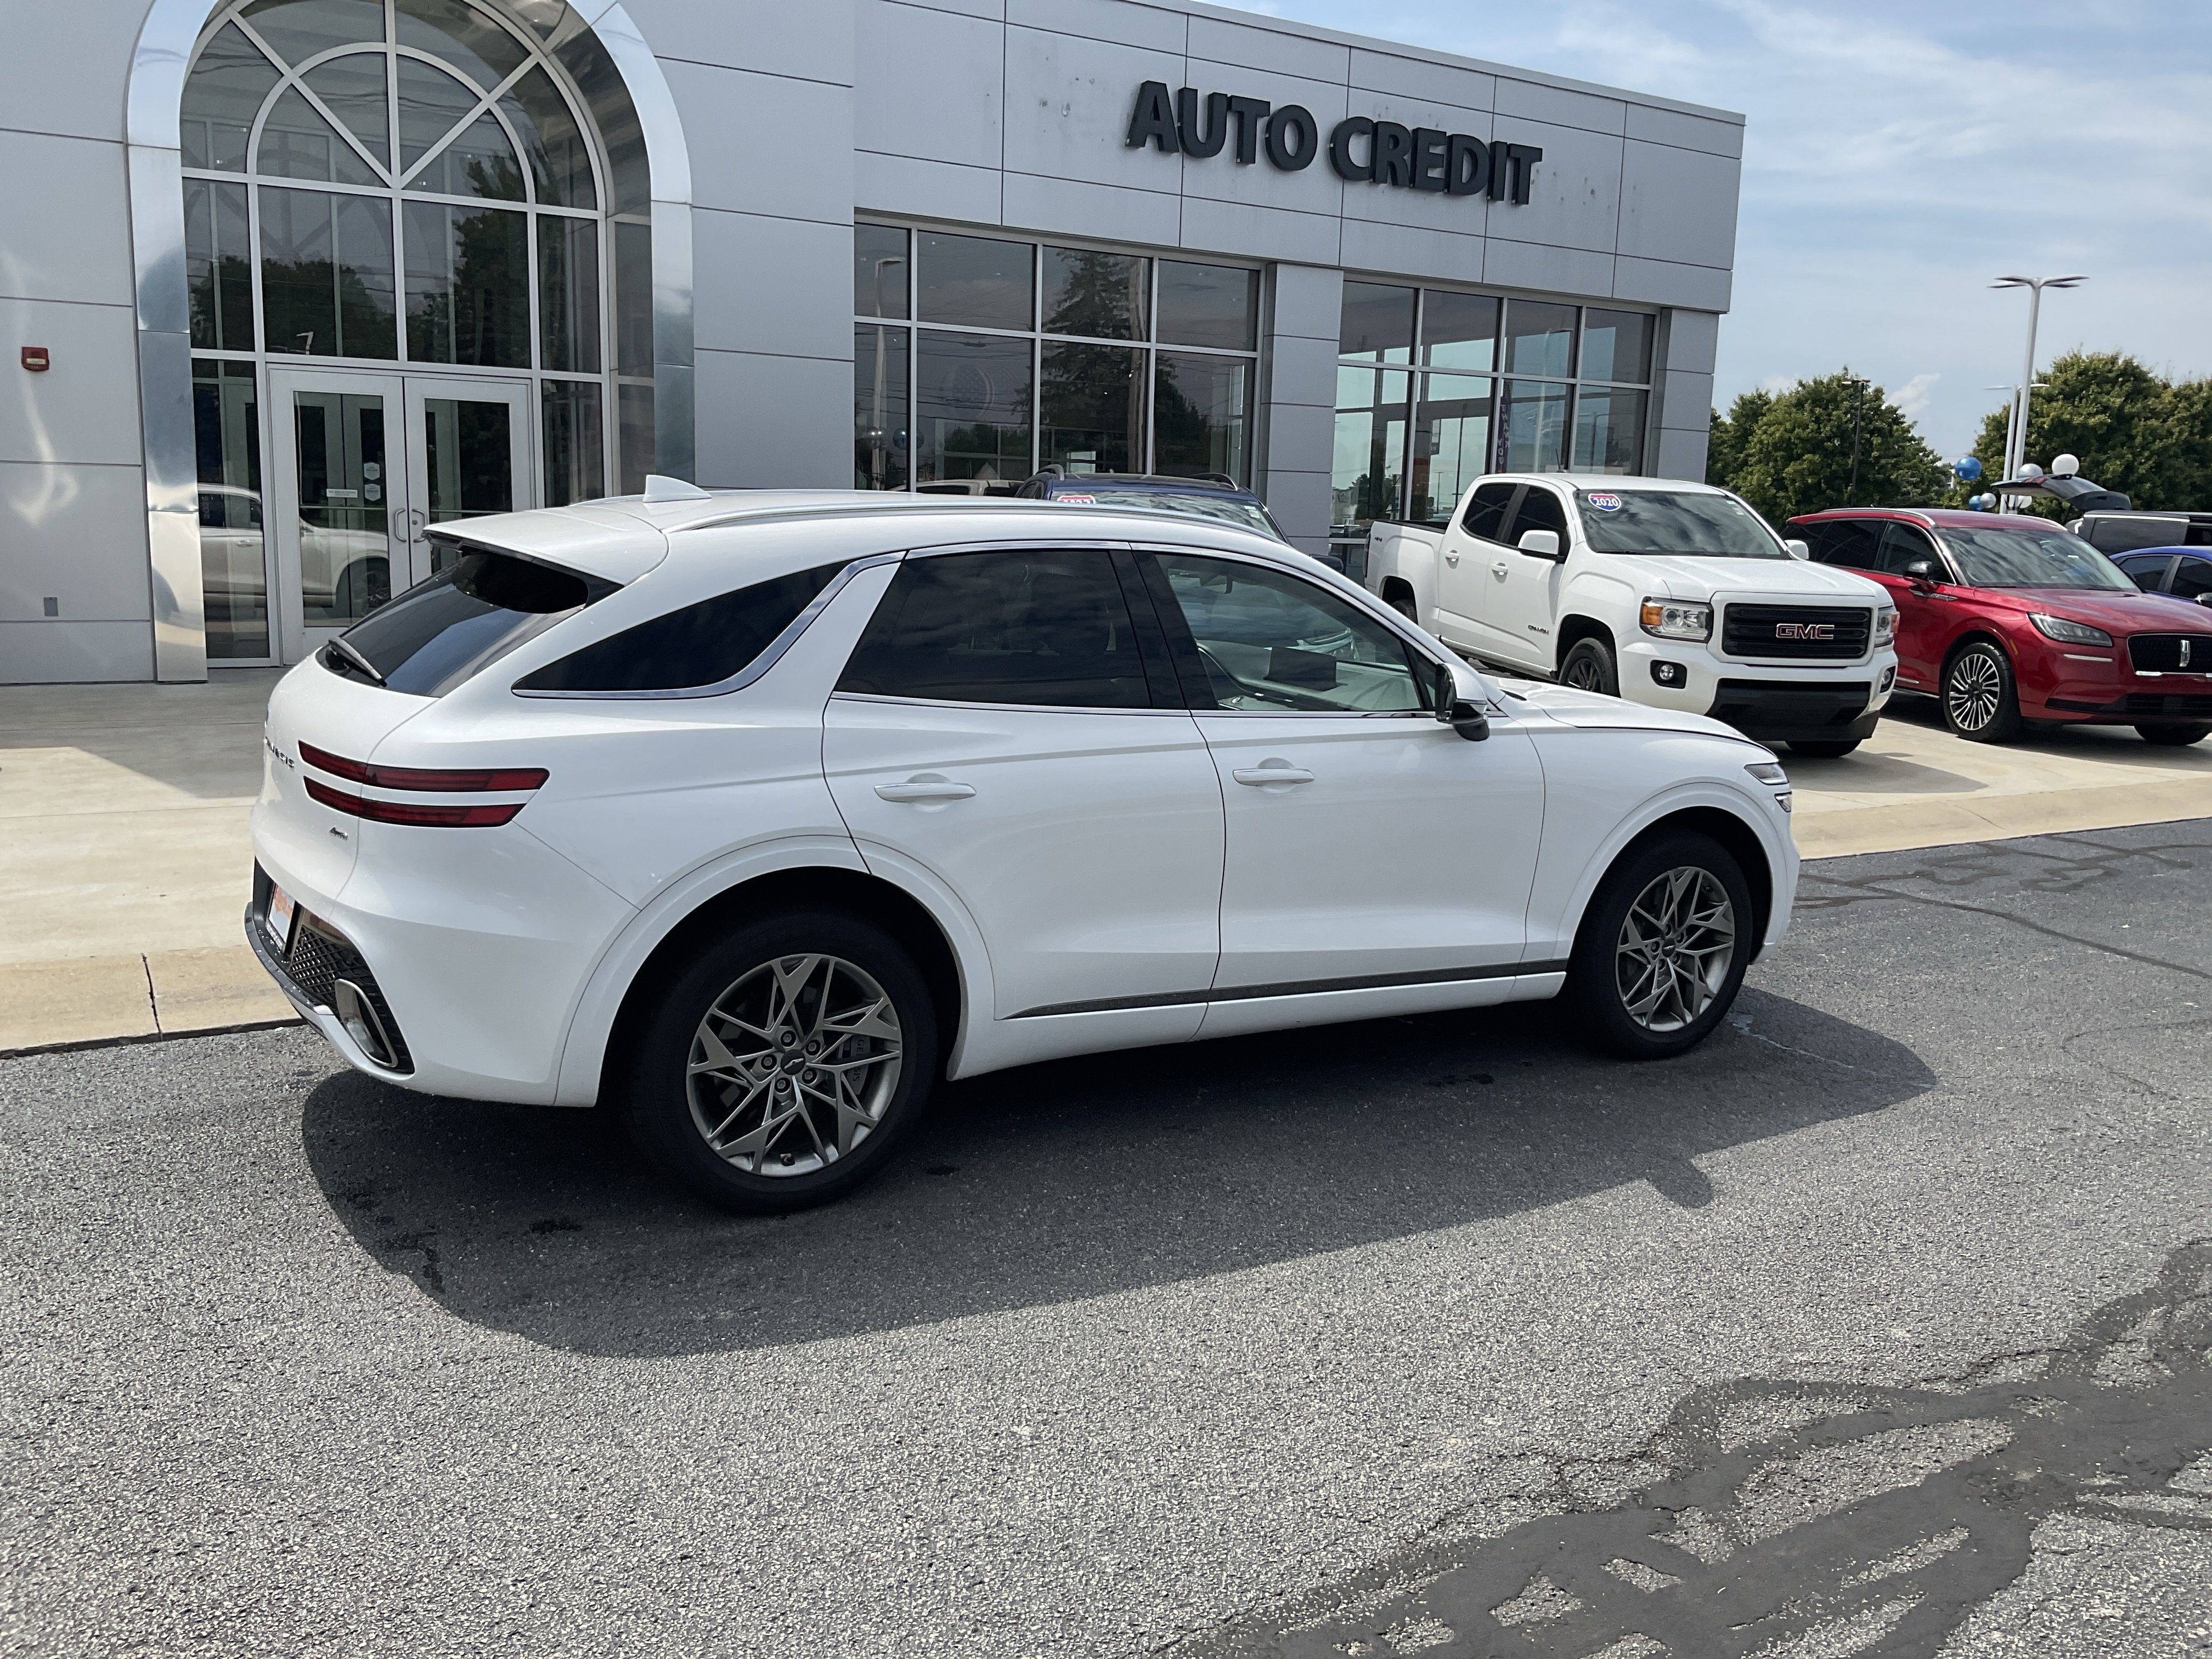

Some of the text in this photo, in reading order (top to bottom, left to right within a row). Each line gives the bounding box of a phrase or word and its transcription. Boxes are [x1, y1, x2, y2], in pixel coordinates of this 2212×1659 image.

[1125, 80, 1543, 205] AUTO CREDIT
[1593, 498, 1618, 507] 2020
[1776, 623, 1835, 639] GMC
[853, 1039, 865, 1082] GESIS
